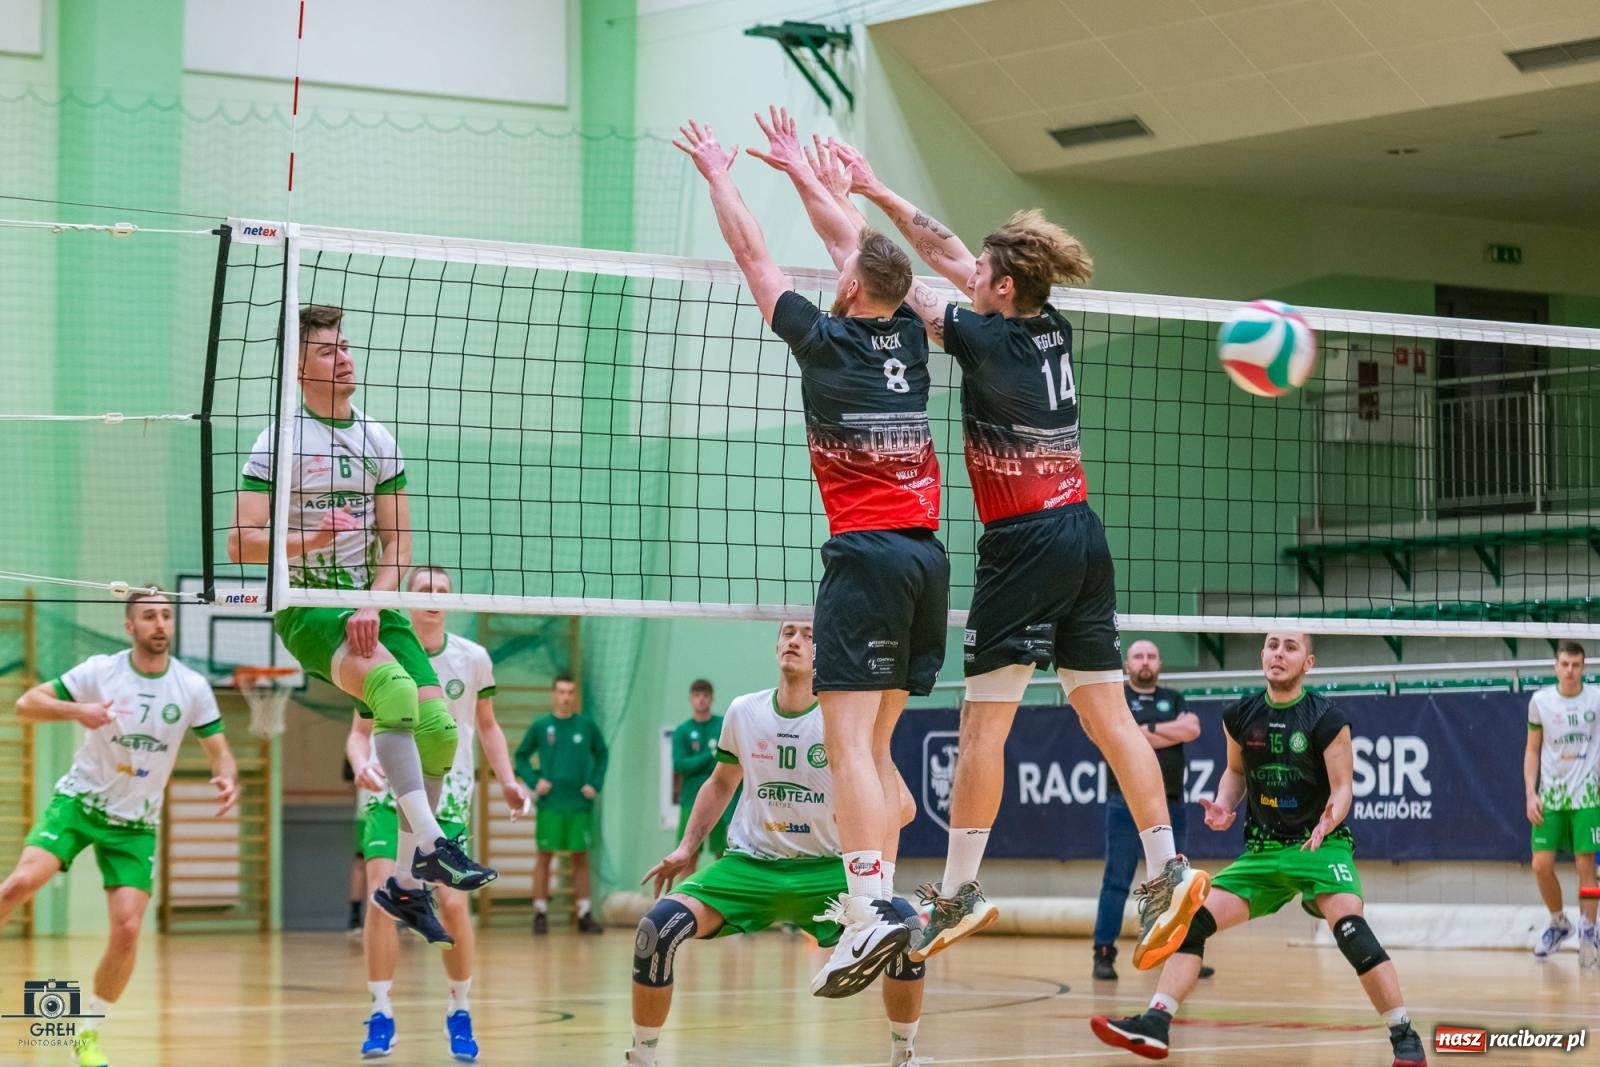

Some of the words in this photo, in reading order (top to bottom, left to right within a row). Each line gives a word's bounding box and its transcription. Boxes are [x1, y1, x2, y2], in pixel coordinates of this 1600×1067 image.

[243, 226, 277, 237] netex
[871, 332, 902, 351] KAZEK
[883, 357, 910, 393] 8
[1041, 352, 1077, 411] 14
[339, 454, 352, 479] 6
[225, 594, 259, 604] netex
[139, 703, 151, 724] 7
[1268, 732, 1284, 754] 15
[777, 745, 797, 770] 10
[1353, 796, 1432, 820] RACIBÓRZ
[1328, 863, 1353, 882] 15
